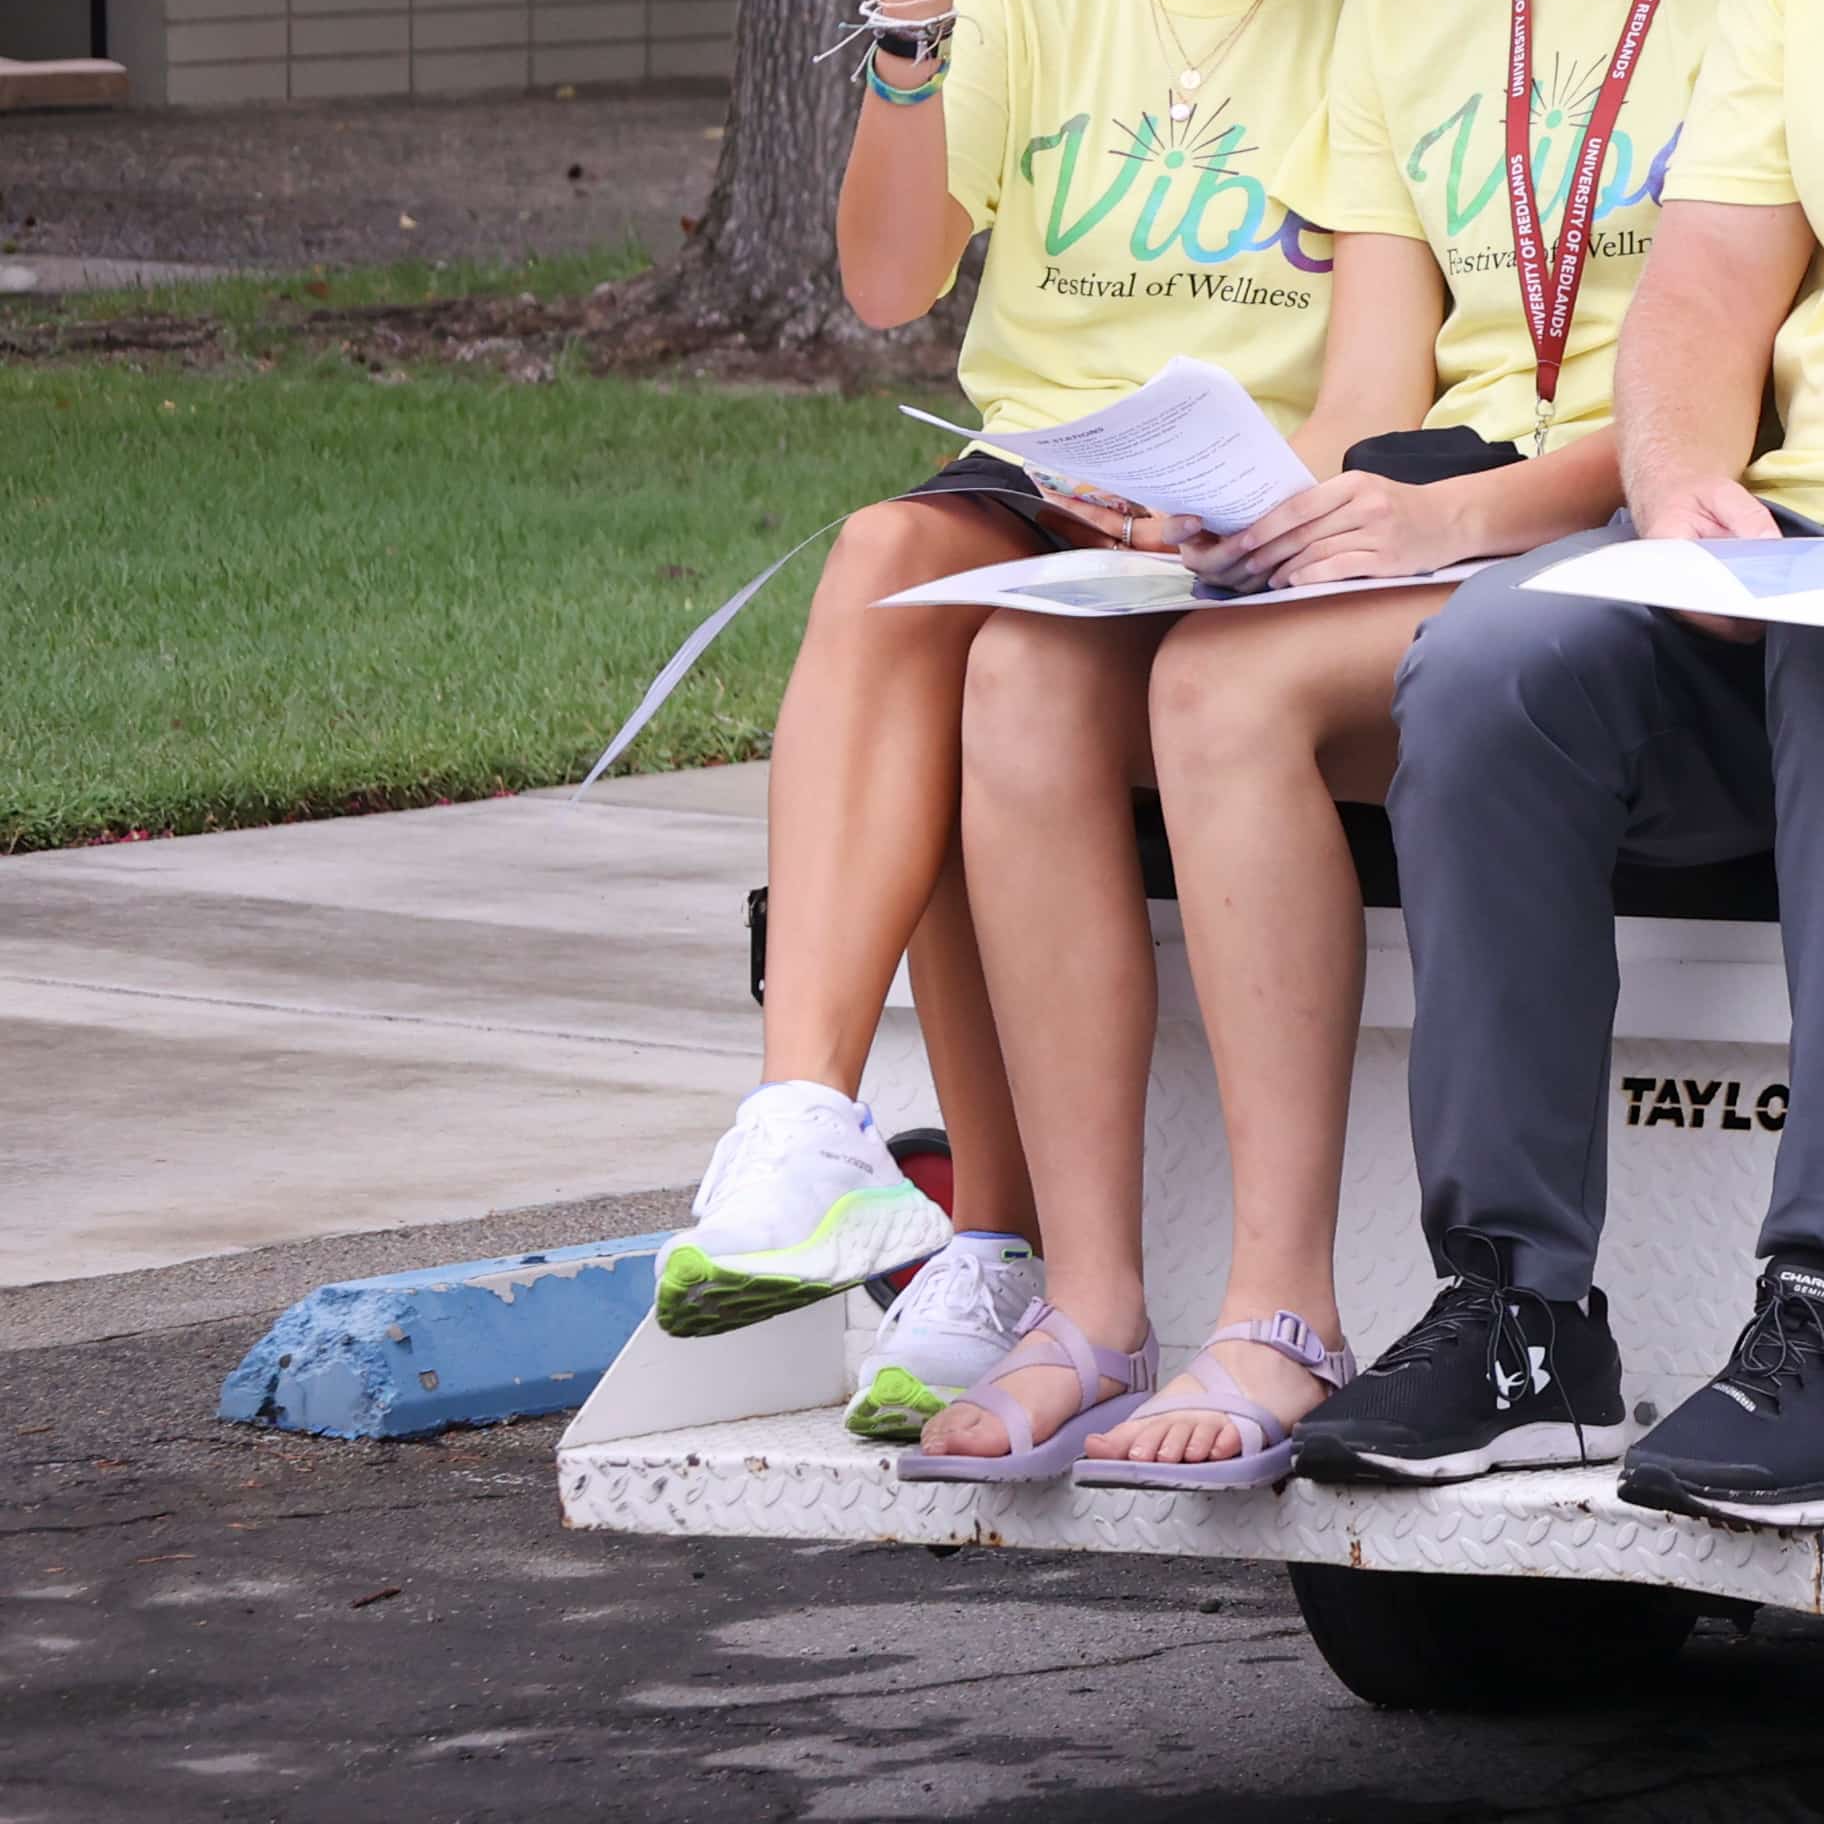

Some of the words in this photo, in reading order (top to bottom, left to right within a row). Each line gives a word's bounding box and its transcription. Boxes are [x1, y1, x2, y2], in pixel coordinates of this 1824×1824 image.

[1511, 16, 1525, 97] UNIVERSITY
[1612, 4, 1650, 80] REDLANDS
[1511, 154, 1532, 236] REDLANDS
[1571, 137, 1602, 230] UNIVERSITY
[1447, 248, 1519, 275] Festiva
[1519, 236, 1536, 259] OF
[1567, 231, 1582, 253] OF
[1038, 266, 1136, 298] Festival
[1146, 273, 1183, 297] of
[1188, 273, 1312, 309] Wellness
[1550, 255, 1578, 338] REDLANDS
